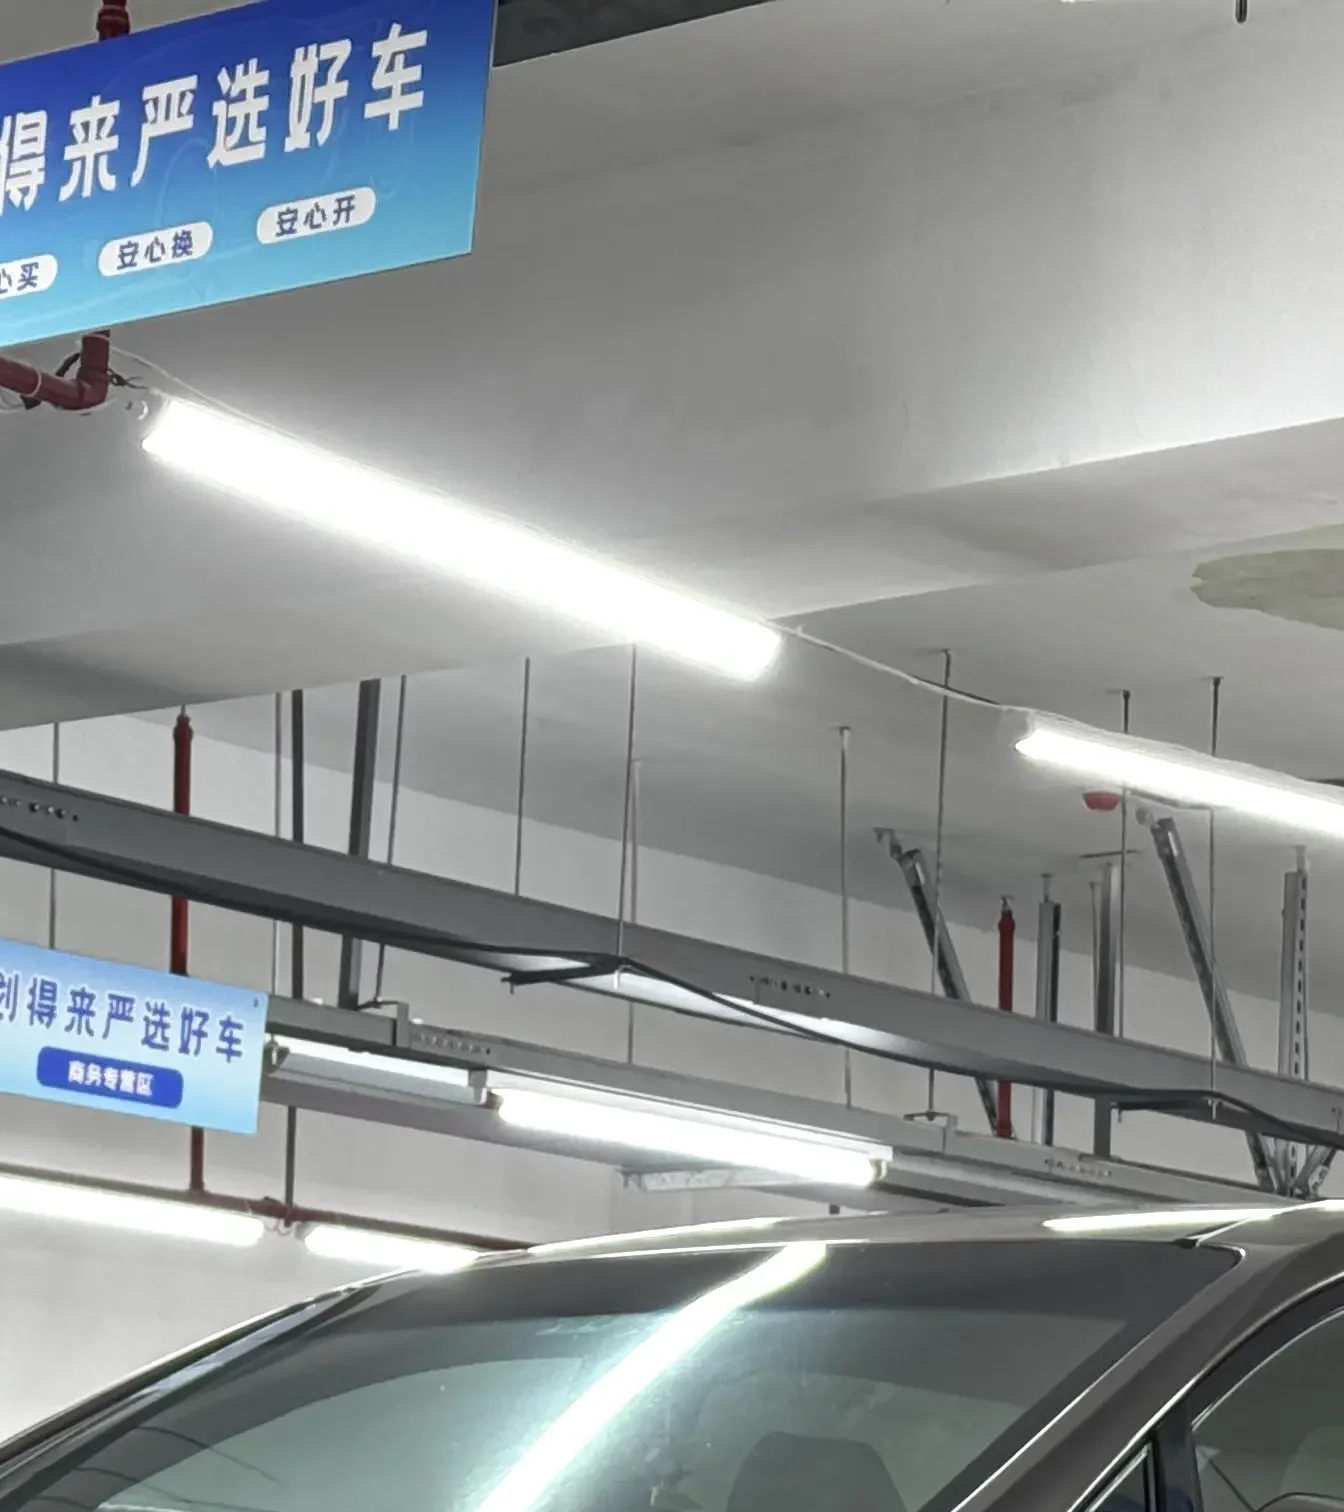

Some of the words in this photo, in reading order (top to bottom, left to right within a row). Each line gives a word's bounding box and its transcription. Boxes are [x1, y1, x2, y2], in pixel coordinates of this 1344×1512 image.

[276, 194, 355, 237] 安心开
[116, 229, 194, 269] 安心换
